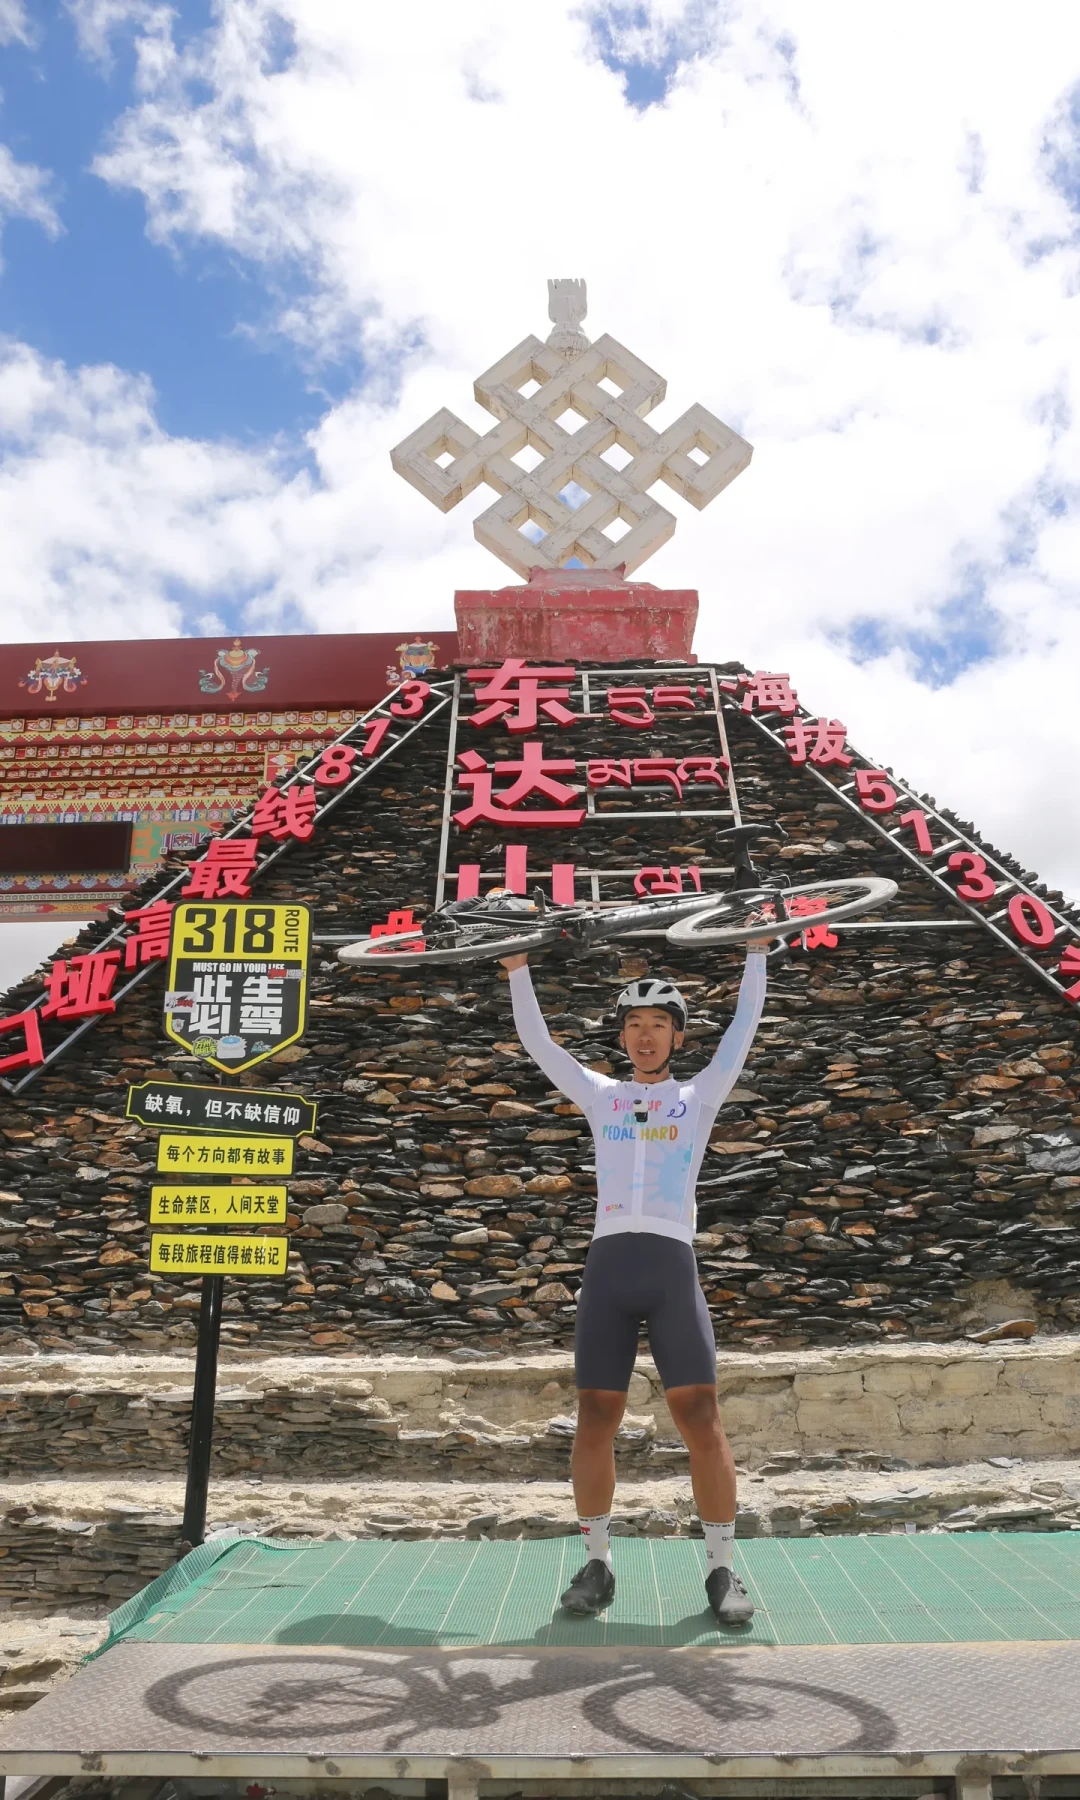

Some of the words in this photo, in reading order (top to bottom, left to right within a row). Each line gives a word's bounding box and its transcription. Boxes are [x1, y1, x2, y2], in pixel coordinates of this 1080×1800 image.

[182, 907, 276, 954] 318
[283, 909, 300, 953] ROUTE
[192, 962, 218, 972] MUST
[219, 962, 231, 972] GO
[232, 963, 242, 972] IN
[243, 963, 267, 973] YOUR
[193, 974, 284, 1004] 此生
[188, 1004, 282, 1035] 必驾
[145, 1093, 300, 1126] 缺氧，但不缺信仰
[602, 1124, 636, 1141] PEDAL
[641, 1124, 678, 1141] HARD
[166, 1144, 286, 1165] 每个方向都有故事
[158, 1195, 279, 1215] 生命禁区，人间天堂
[158, 1243, 280, 1265] 每段旅程值得被铭记
